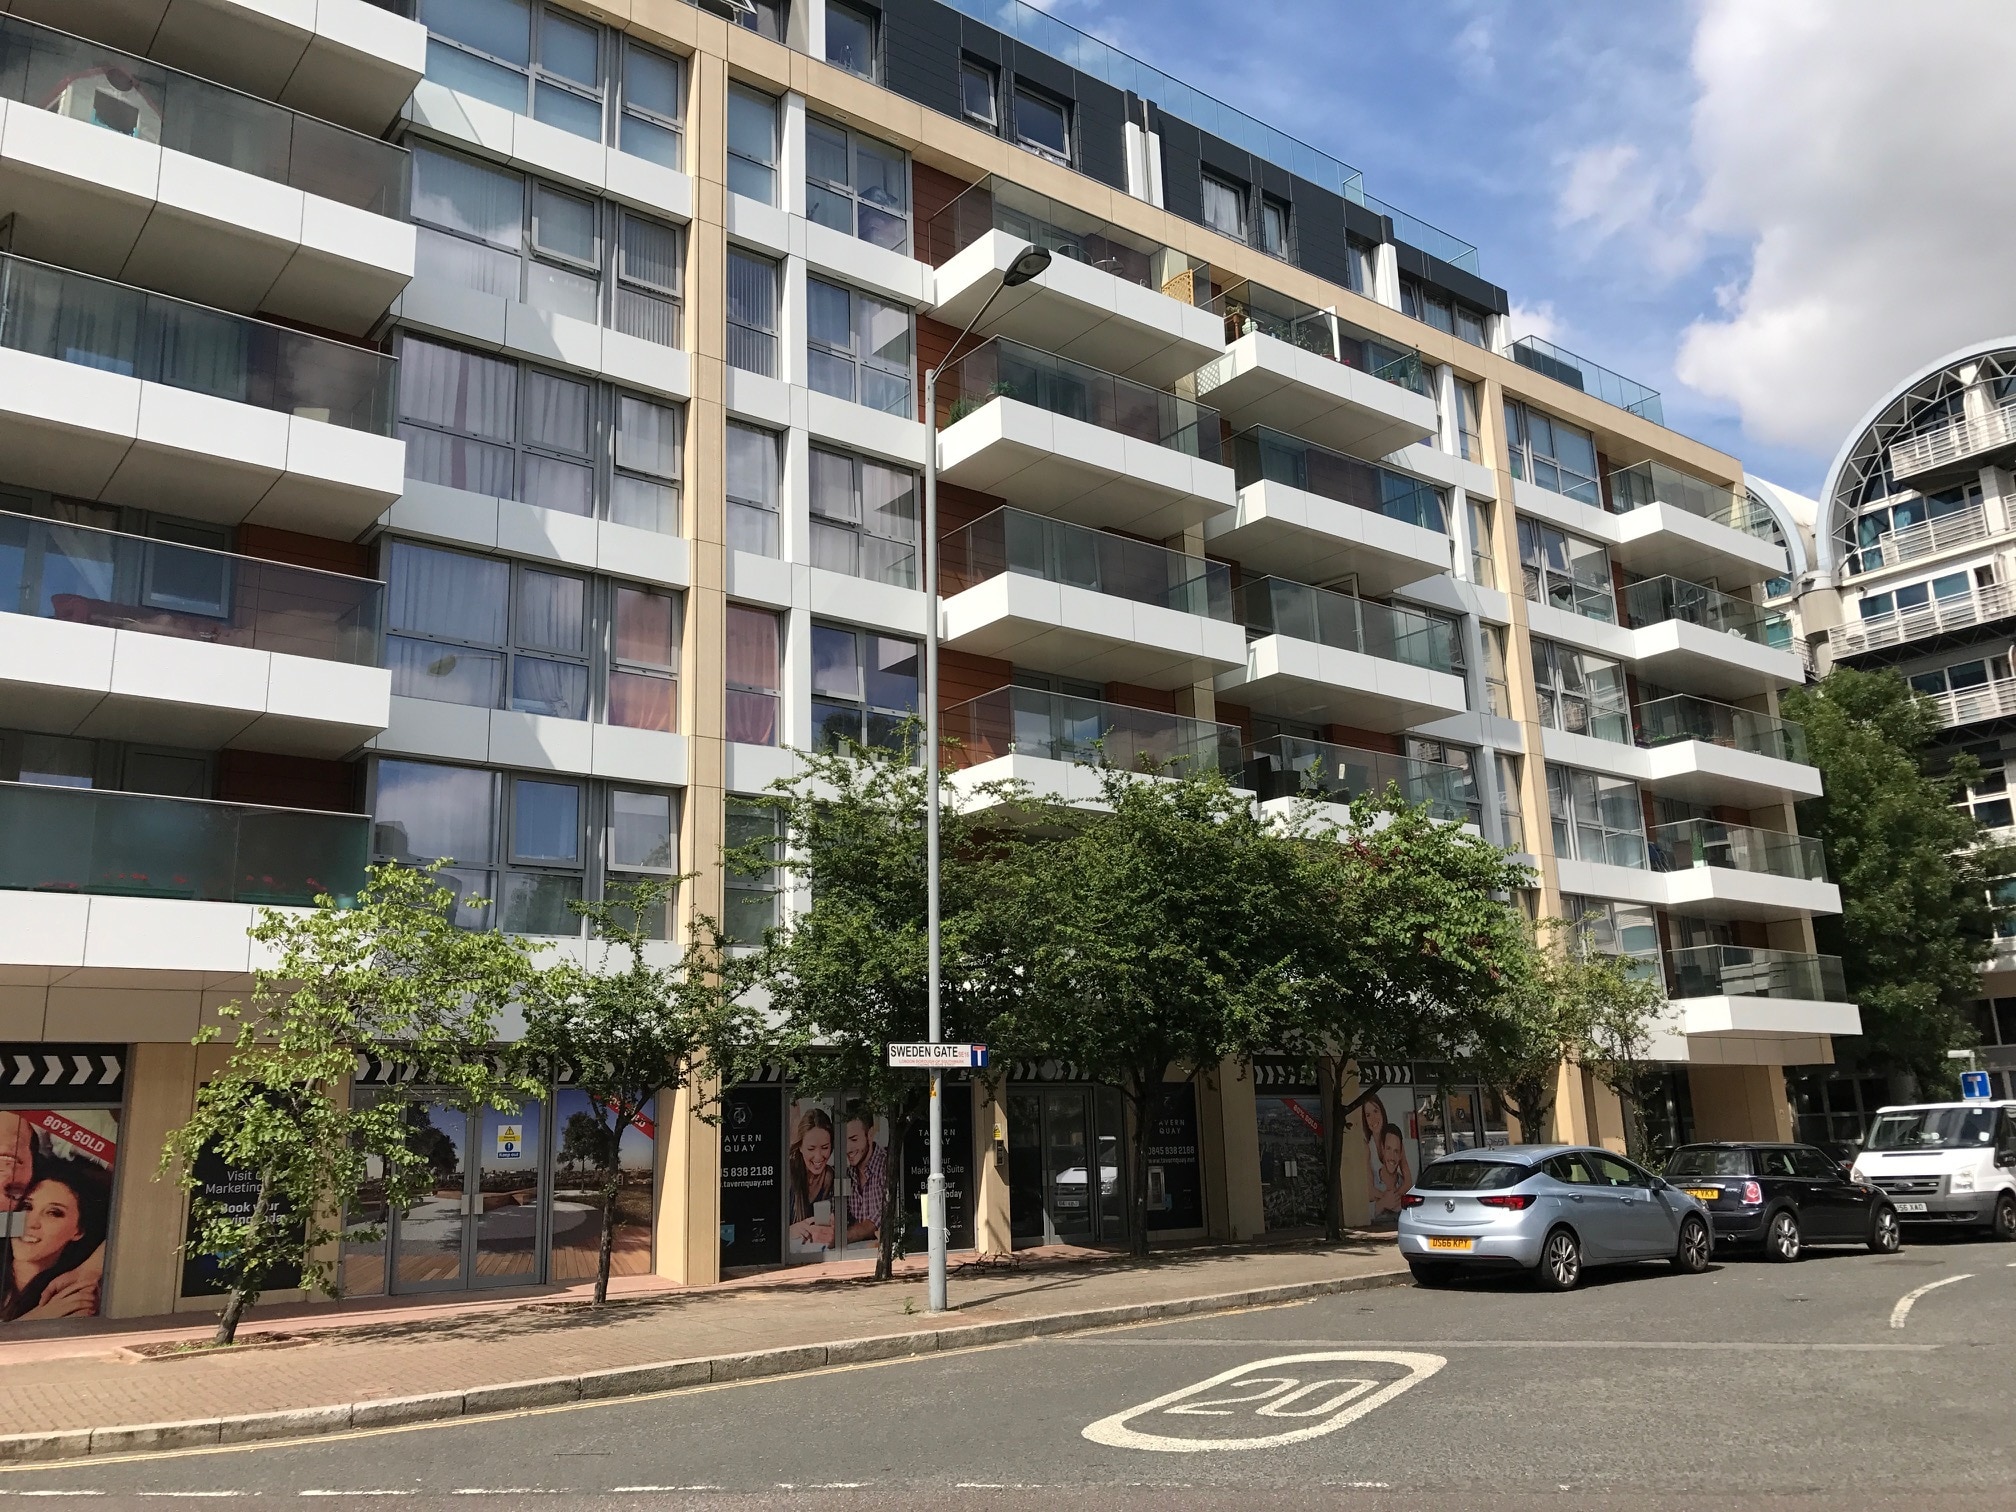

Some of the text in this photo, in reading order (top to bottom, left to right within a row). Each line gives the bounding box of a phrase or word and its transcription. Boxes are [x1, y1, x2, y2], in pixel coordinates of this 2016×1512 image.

[891, 1046, 931, 1057] SWEDEN
[934, 1046, 958, 1057] GATE
[43, 1115, 105, 1152] 80% SOLD
[724, 1134, 762, 1142] AVERN
[724, 1144, 756, 1152] QUAY
[730, 1167, 748, 1177] 838
[750, 1165, 774, 1176] 2188
[946, 1164, 964, 1174] Suite
[227, 1170, 252, 1181] Visit
[945, 1189, 963, 1199] oday
[1432, 1237, 1468, 1247] DS66 KPY
[1163, 1378, 1380, 1417] 20
